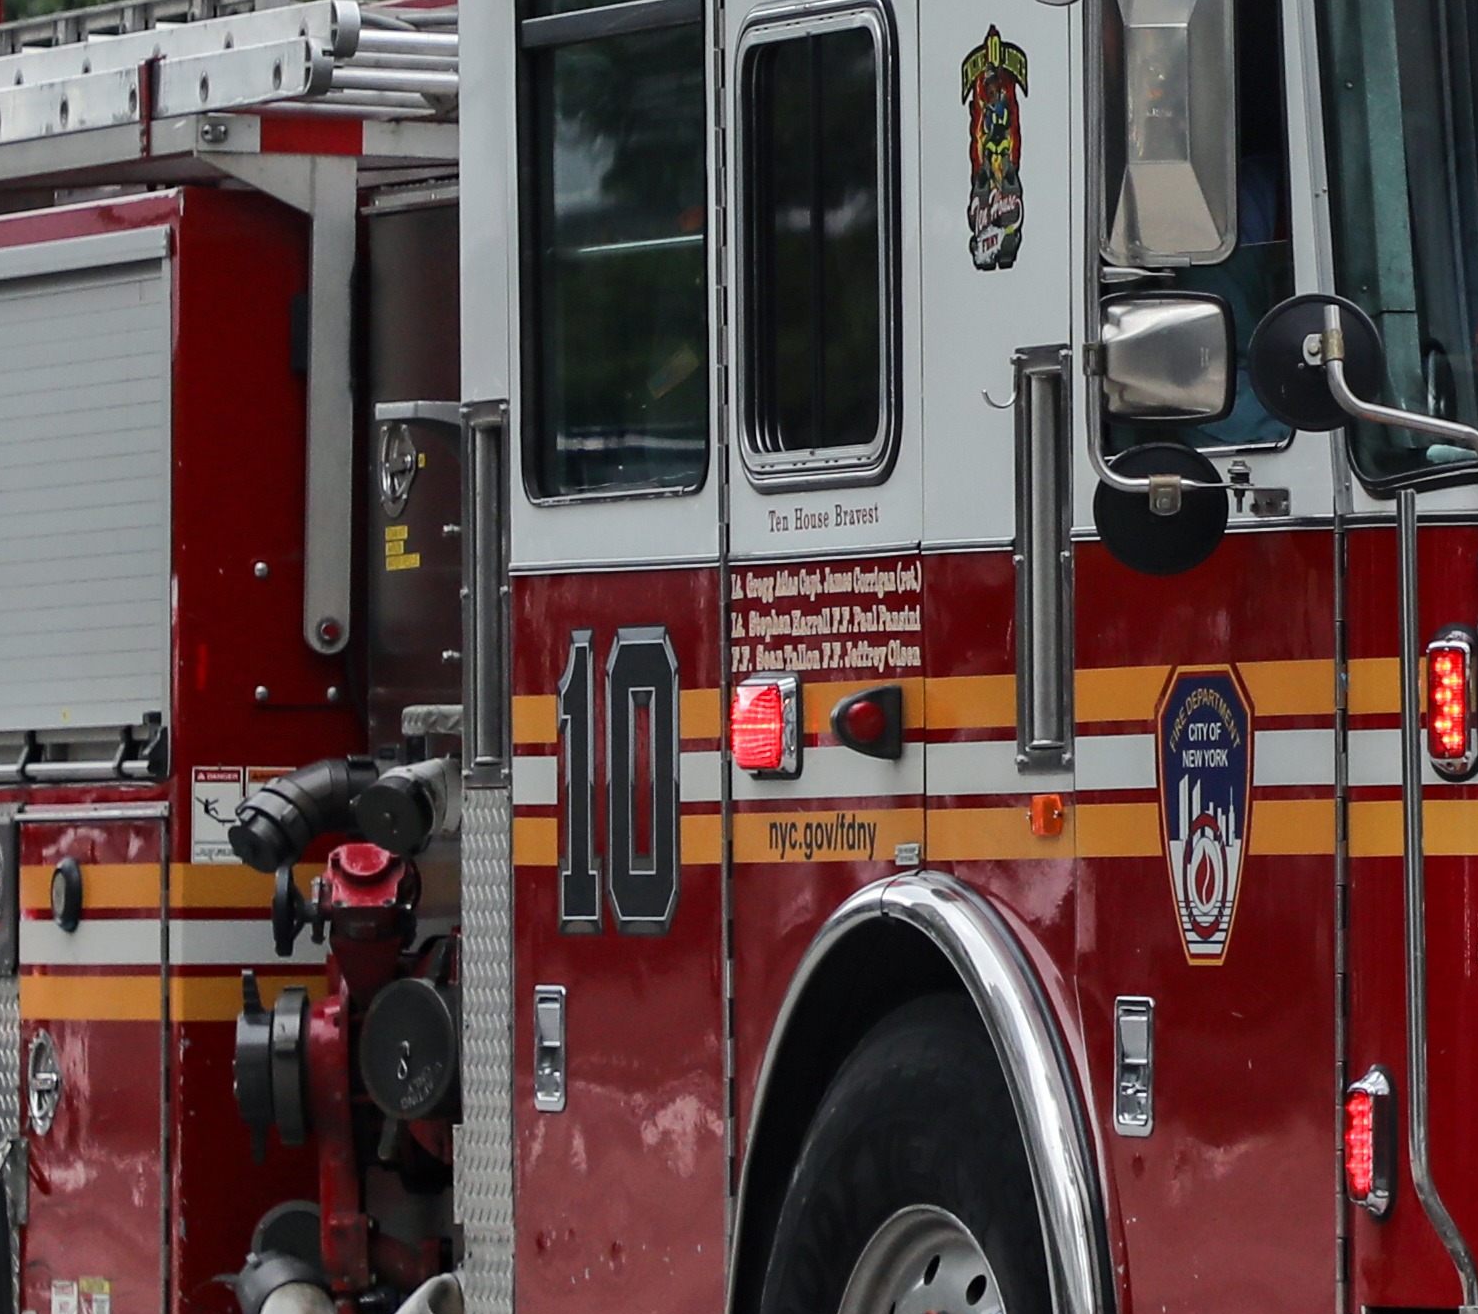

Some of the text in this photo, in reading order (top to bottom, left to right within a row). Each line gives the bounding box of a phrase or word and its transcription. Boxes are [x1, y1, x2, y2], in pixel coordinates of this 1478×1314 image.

[768, 502, 879, 533] Ten House Bravest
[824, 567, 852, 594] James
[748, 609, 791, 642] Stephen
[852, 604, 878, 632] Paul
[756, 644, 784, 670] Sean
[784, 644, 821, 671] Tallon
[844, 640, 887, 673] Jeffrey
[887, 639, 921, 666] Olsen
[1169, 688, 1241, 753] FIRE DEPARTMENT
[1188, 722, 1222, 741] CITY OF
[1182, 749, 1228, 768] NEW YORK
[207, 773, 238, 781] DANGER
[556, 626, 680, 934] 10
[769, 812, 877, 860] nyc.gov/fdny
